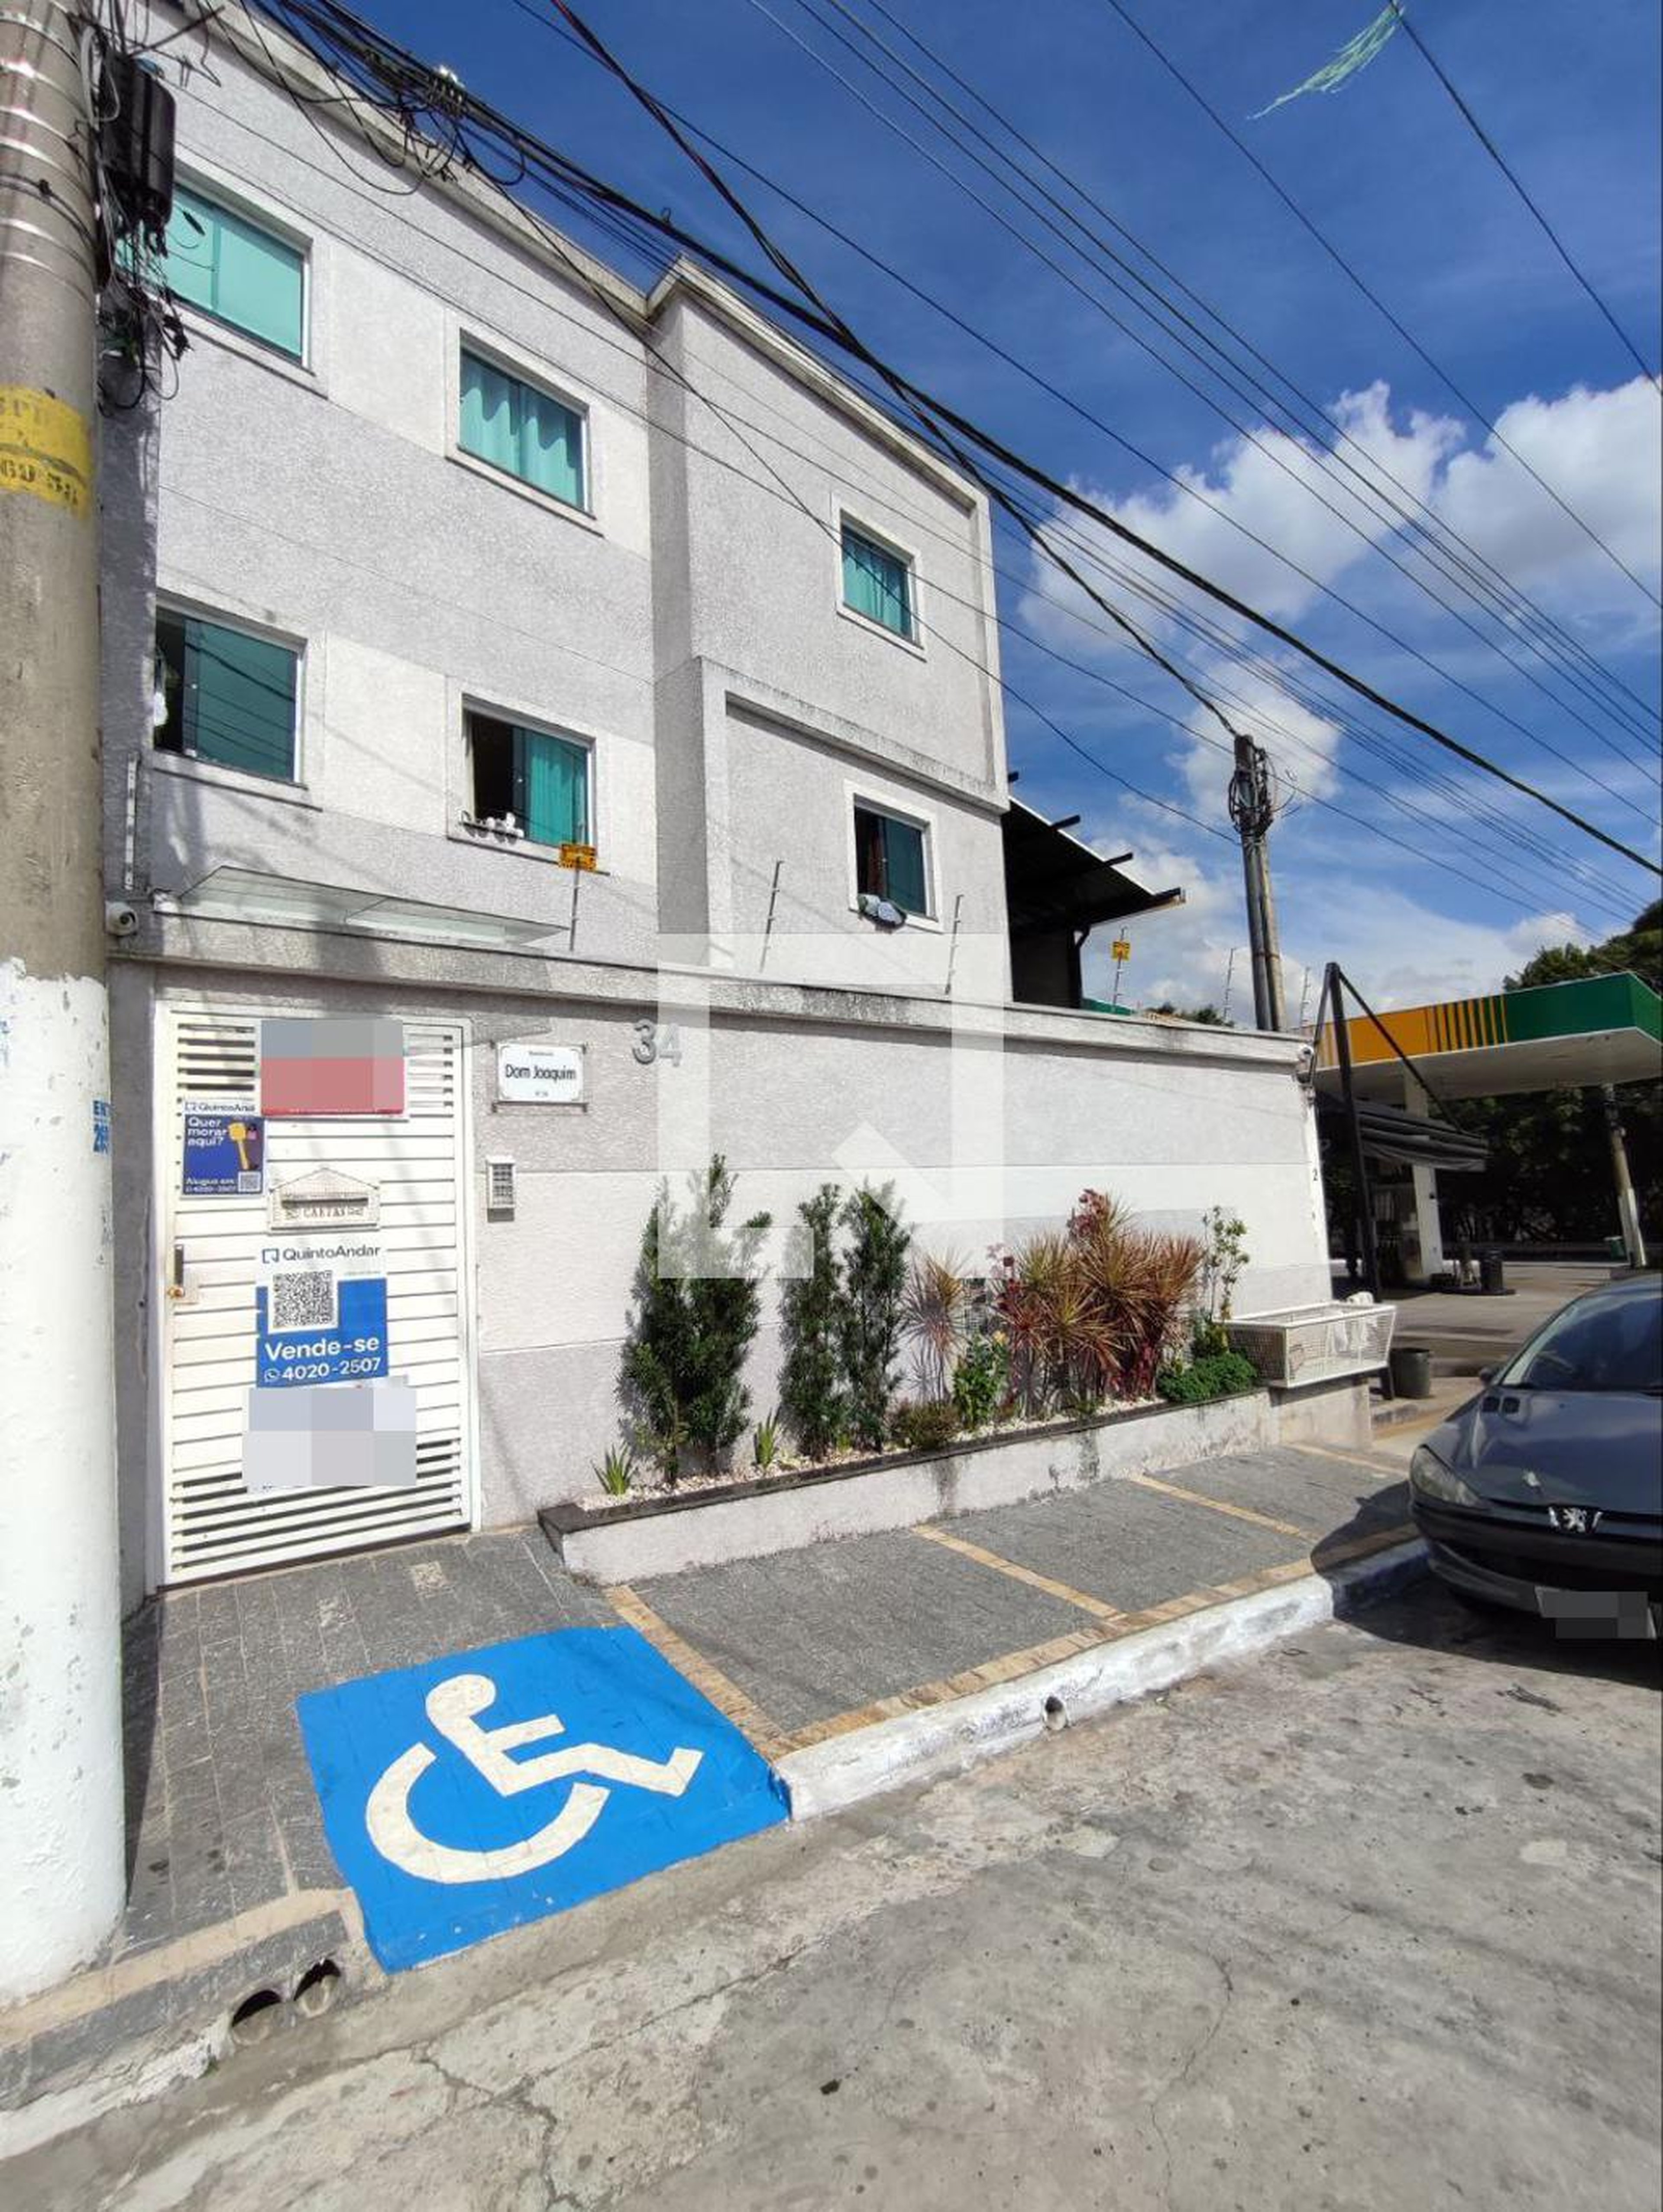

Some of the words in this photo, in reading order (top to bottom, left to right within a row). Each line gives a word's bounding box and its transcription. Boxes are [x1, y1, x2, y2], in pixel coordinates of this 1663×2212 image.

[632, 1019, 683, 1068] 34
[505, 1064, 530, 1078] Dom
[533, 1065, 576, 1083] Joaquim
[188, 1116, 221, 1127] Quer
[188, 1128, 227, 1137] morar
[188, 1136, 224, 1148] aqui?
[283, 1244, 380, 1261] QuintoAndar
[265, 1337, 380, 1361] Vende-se
[282, 1357, 381, 1381] 4020-2507
